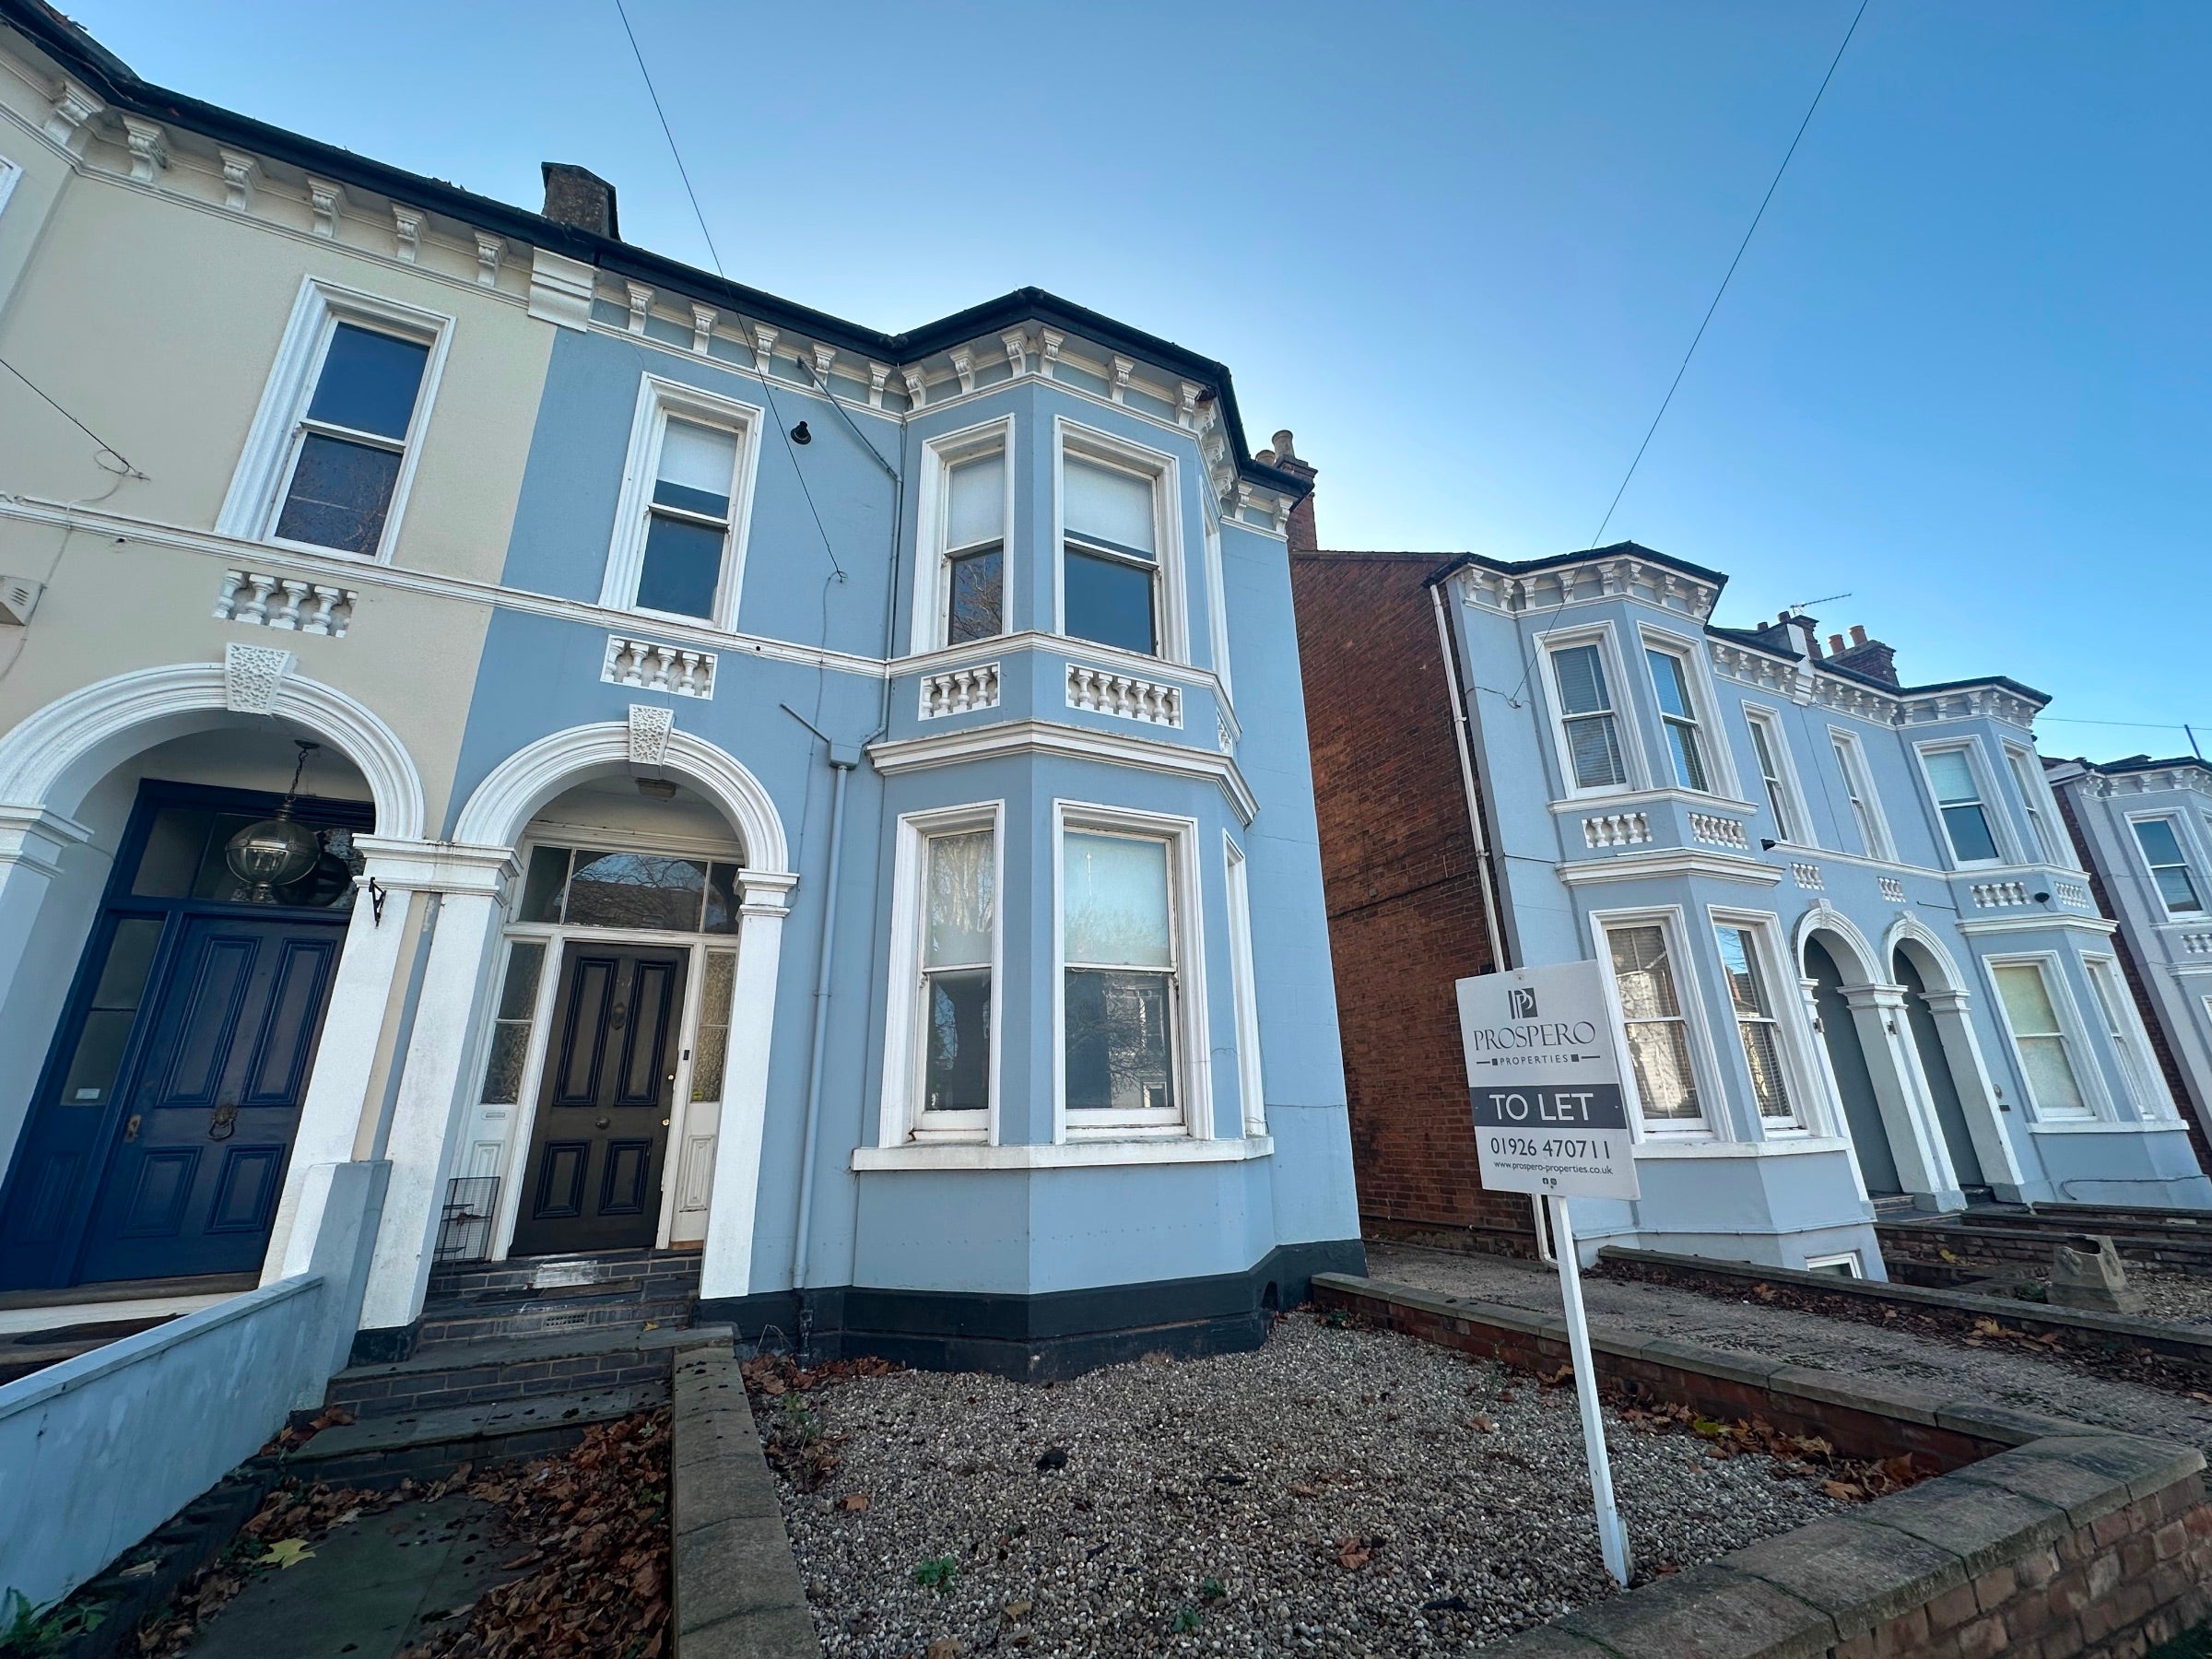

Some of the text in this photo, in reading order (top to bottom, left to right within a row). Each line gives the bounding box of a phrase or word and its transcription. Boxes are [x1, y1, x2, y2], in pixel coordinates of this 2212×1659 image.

[1474, 1020, 1596, 1052] PROSPERO
[1500, 1053, 1569, 1065] PROPERTIES
[1488, 1092, 1594, 1121] TO LET
[1490, 1137, 1610, 1159] 01926 470711
[1493, 1160, 1613, 1175] www.prospero-properties.co.uk
